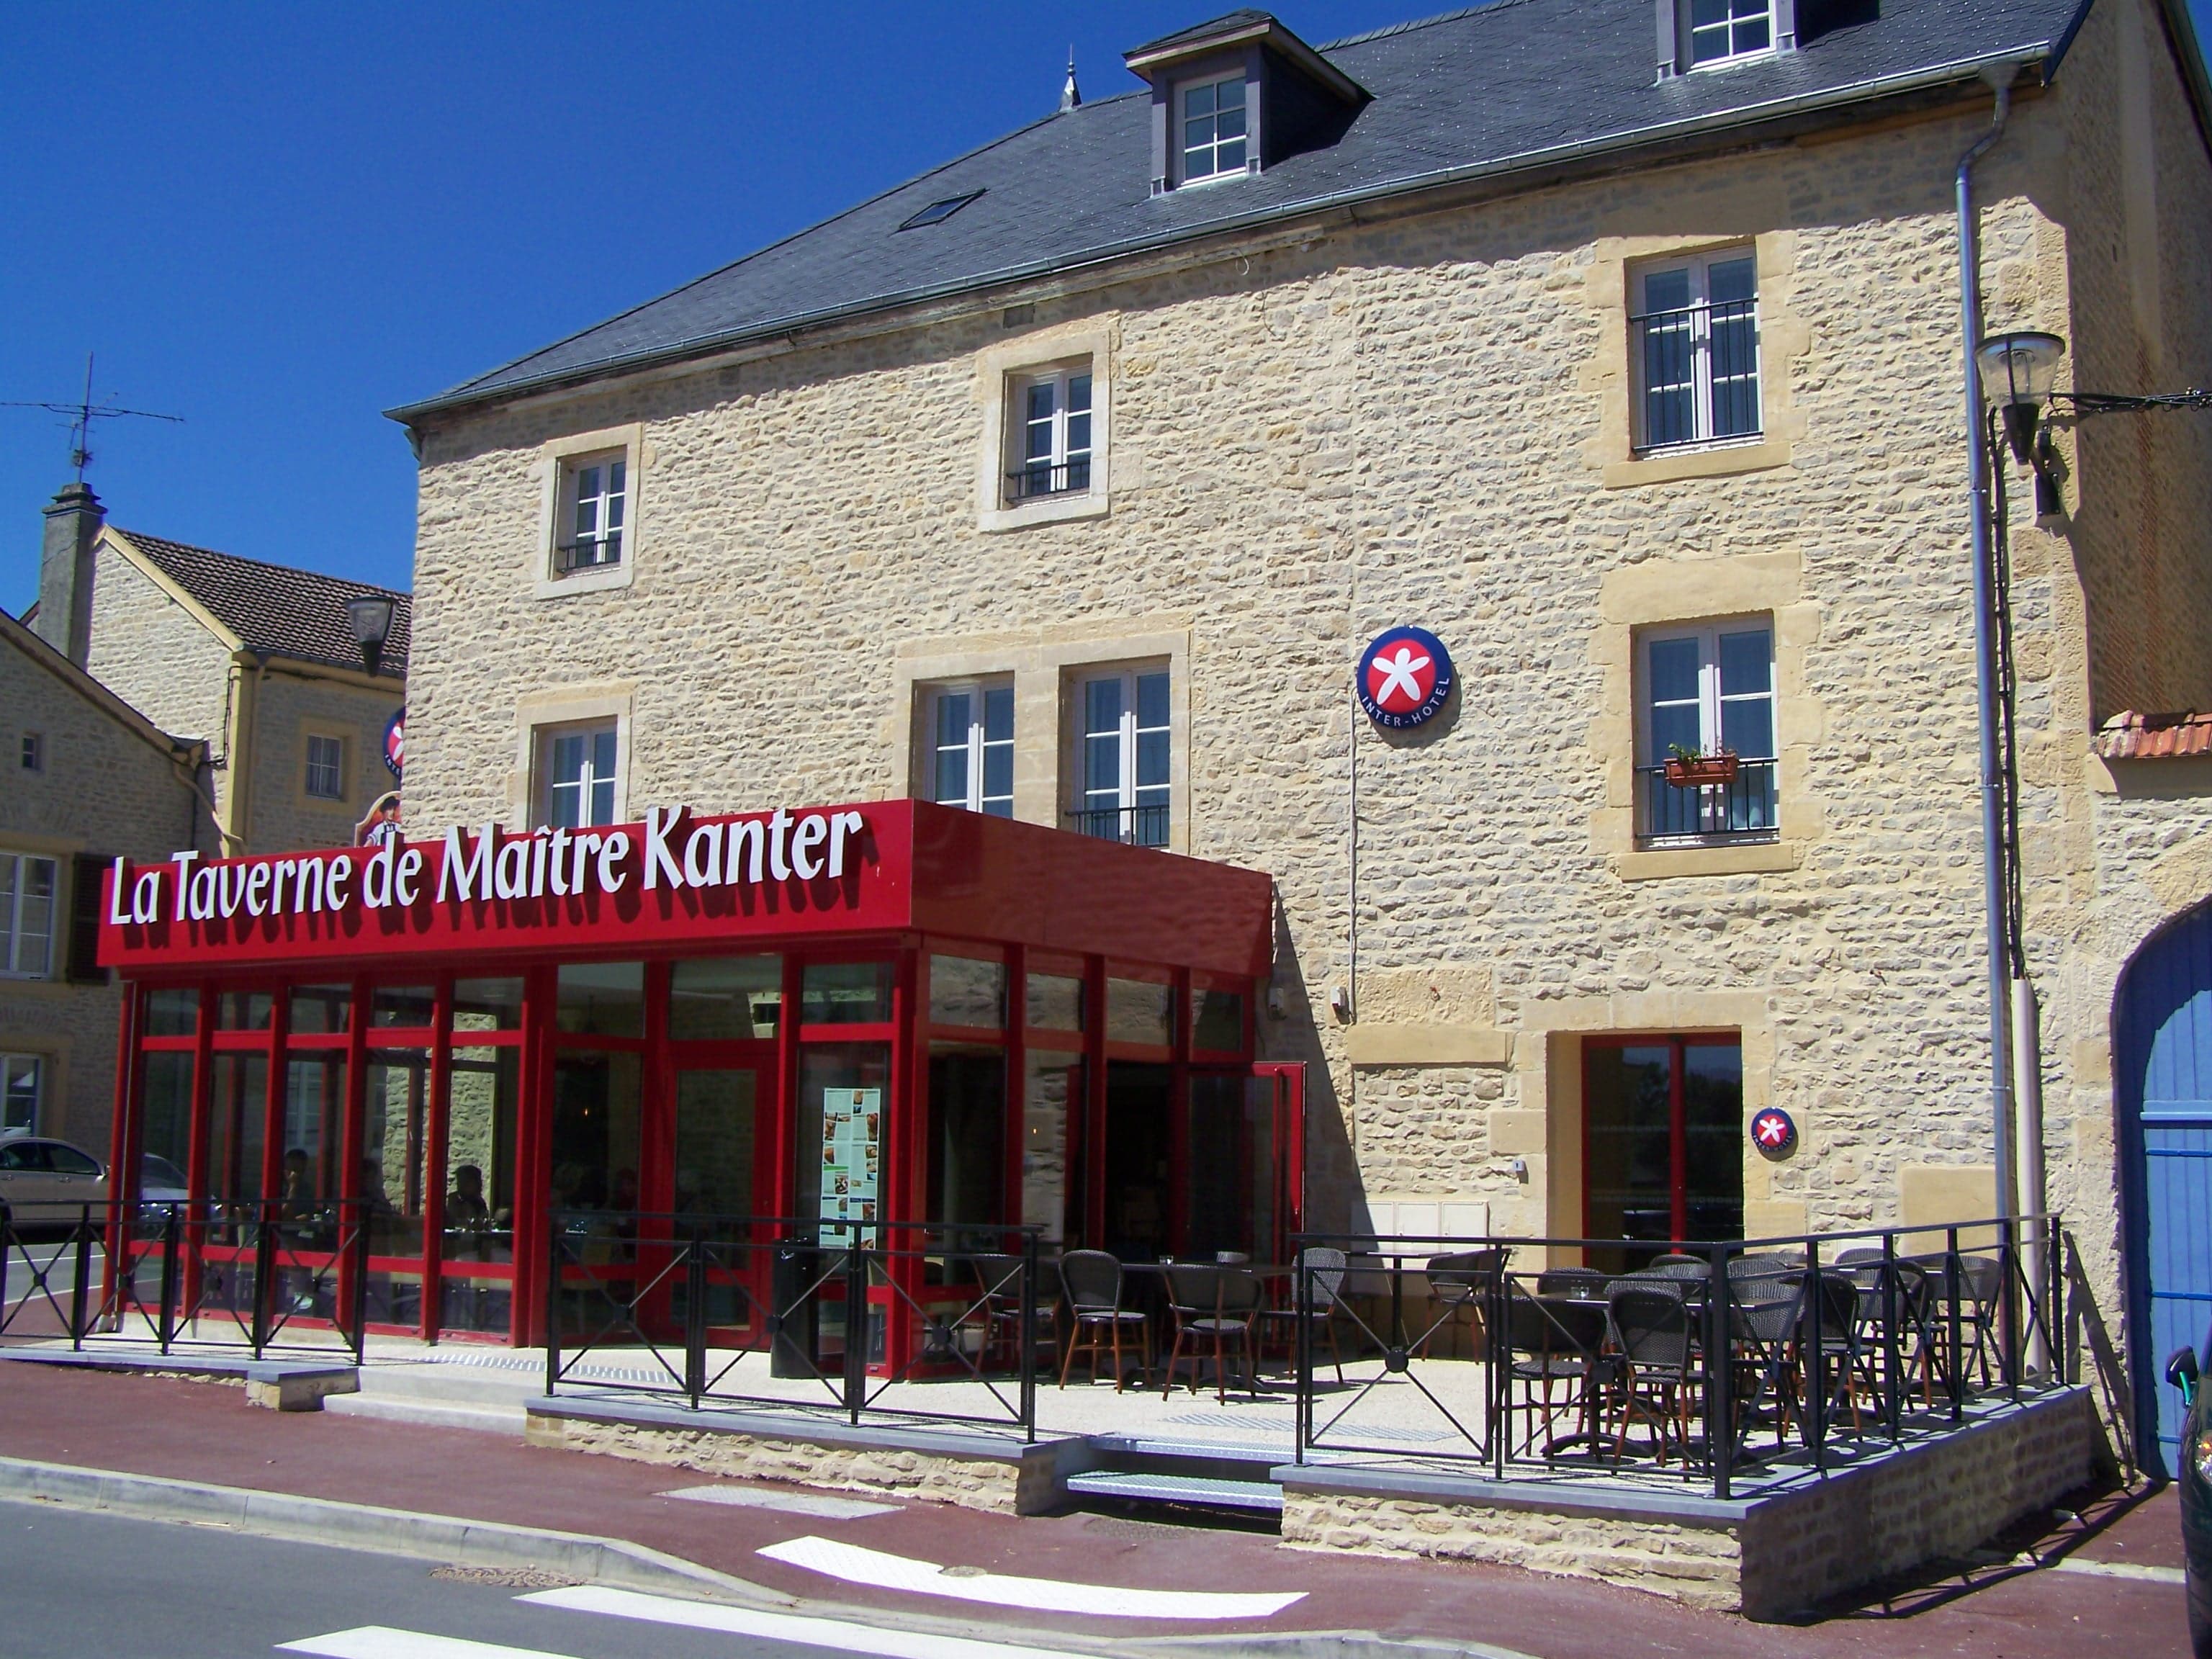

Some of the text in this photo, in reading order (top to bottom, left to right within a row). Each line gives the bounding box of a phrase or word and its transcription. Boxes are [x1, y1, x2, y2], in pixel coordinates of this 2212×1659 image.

[1362, 678, 1449, 727] INTER-HOTEL
[110, 804, 863, 925] La Taverne de Maître Kanter
